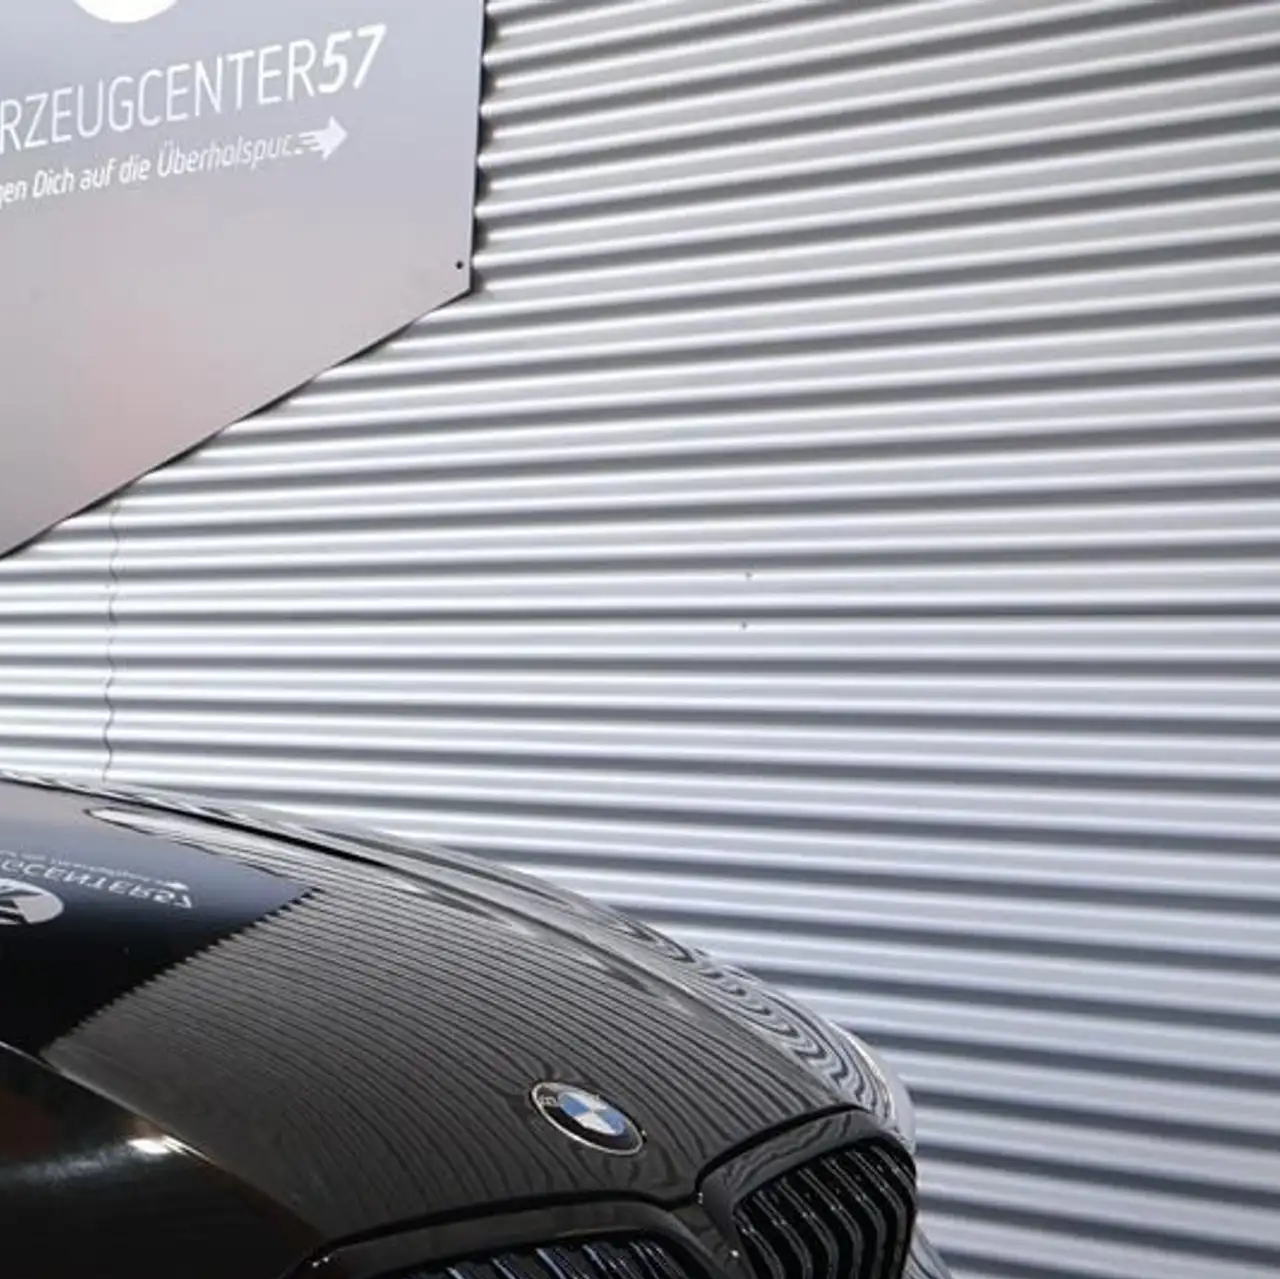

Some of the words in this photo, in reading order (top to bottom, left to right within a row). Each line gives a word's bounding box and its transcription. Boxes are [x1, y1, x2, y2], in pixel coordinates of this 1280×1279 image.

[32, 165, 75, 199] Dich
[79, 156, 117, 192] auf
[119, 152, 151, 184] die
